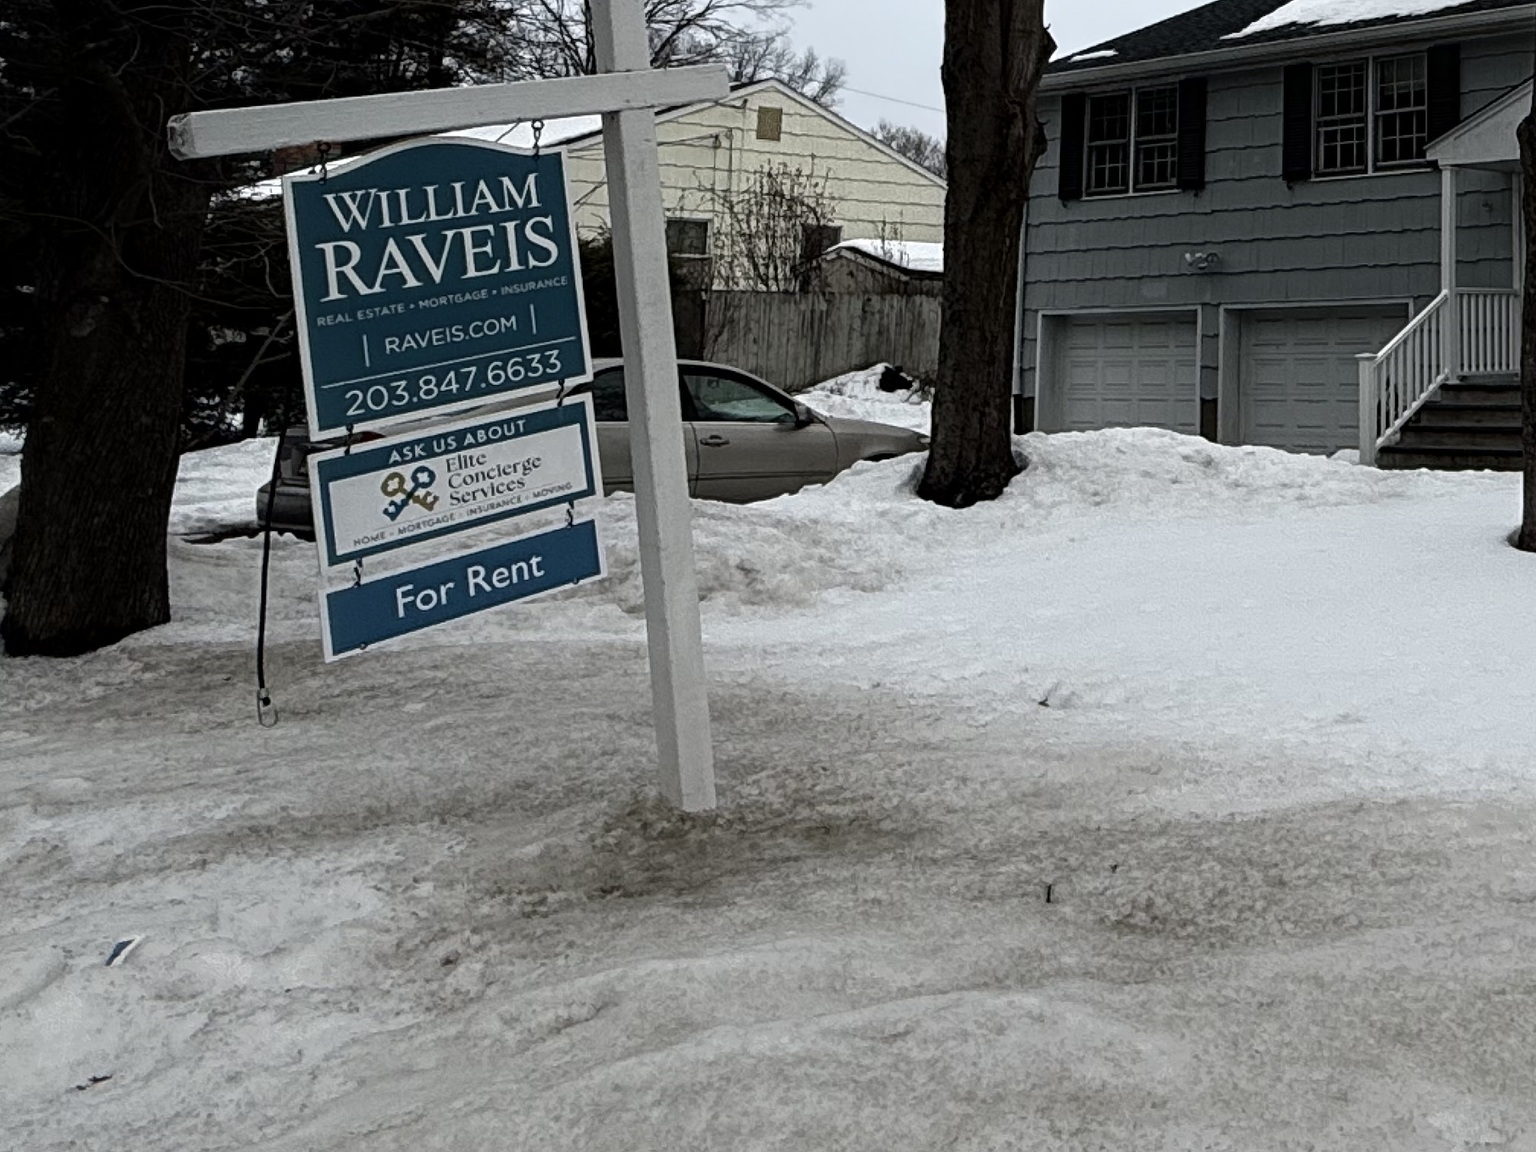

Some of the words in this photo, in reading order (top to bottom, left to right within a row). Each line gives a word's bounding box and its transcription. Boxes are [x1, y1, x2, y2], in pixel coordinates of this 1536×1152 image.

[323, 173, 542, 233] WILLIAM
[315, 215, 559, 302] RAVEIS
[317, 311, 352, 327] REAL
[357, 303, 406, 320] ESTATE
[418, 288, 488, 309] MORTGAGE
[501, 276, 568, 295] INSURANCE
[385, 315, 517, 354] RAVEIS.COM
[345, 350, 562, 416] 203.847.6633
[389, 443, 425, 464] ASK
[433, 436, 457, 454] US
[464, 420, 527, 447] ABOUT
[446, 452, 487, 473] Elite
[448, 455, 542, 489] Concierge
[449, 479, 526, 506] Services
[354, 531, 386, 547] HOME
[398, 513, 455, 534] MORTGAGE
[467, 496, 522, 517] INSURANCE
[532, 482, 573, 499] MOVING
[396, 579, 454, 618] For
[467, 554, 546, 597] Rent
